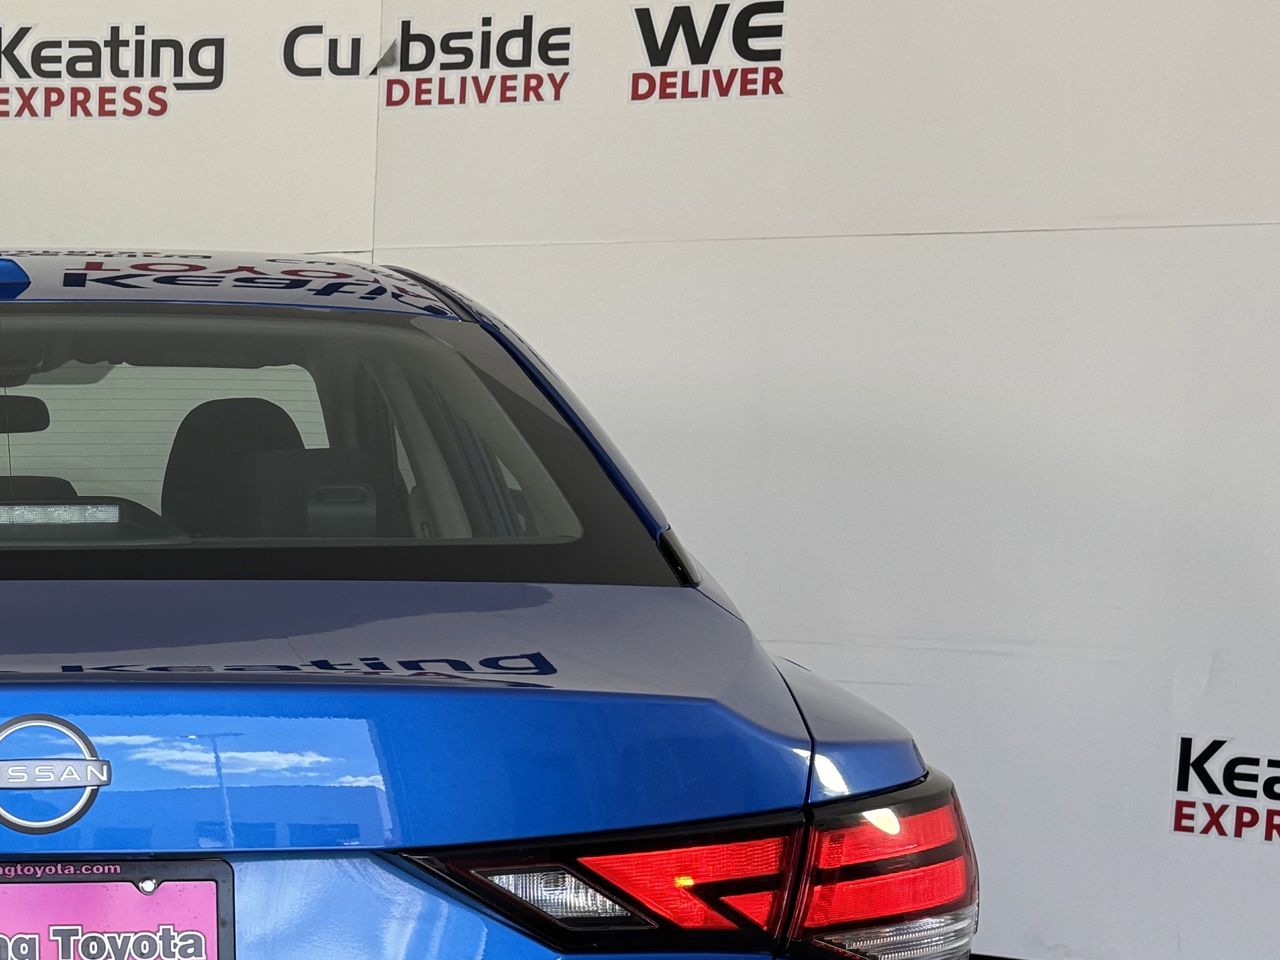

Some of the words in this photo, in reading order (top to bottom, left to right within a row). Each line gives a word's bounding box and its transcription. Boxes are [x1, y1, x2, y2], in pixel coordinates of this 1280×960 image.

[283, 15, 570, 77] Cubside
[634, 1, 785, 67] WE
[385, 72, 570, 107] DELIVERY
[630, 66, 784, 102] DELIVER
